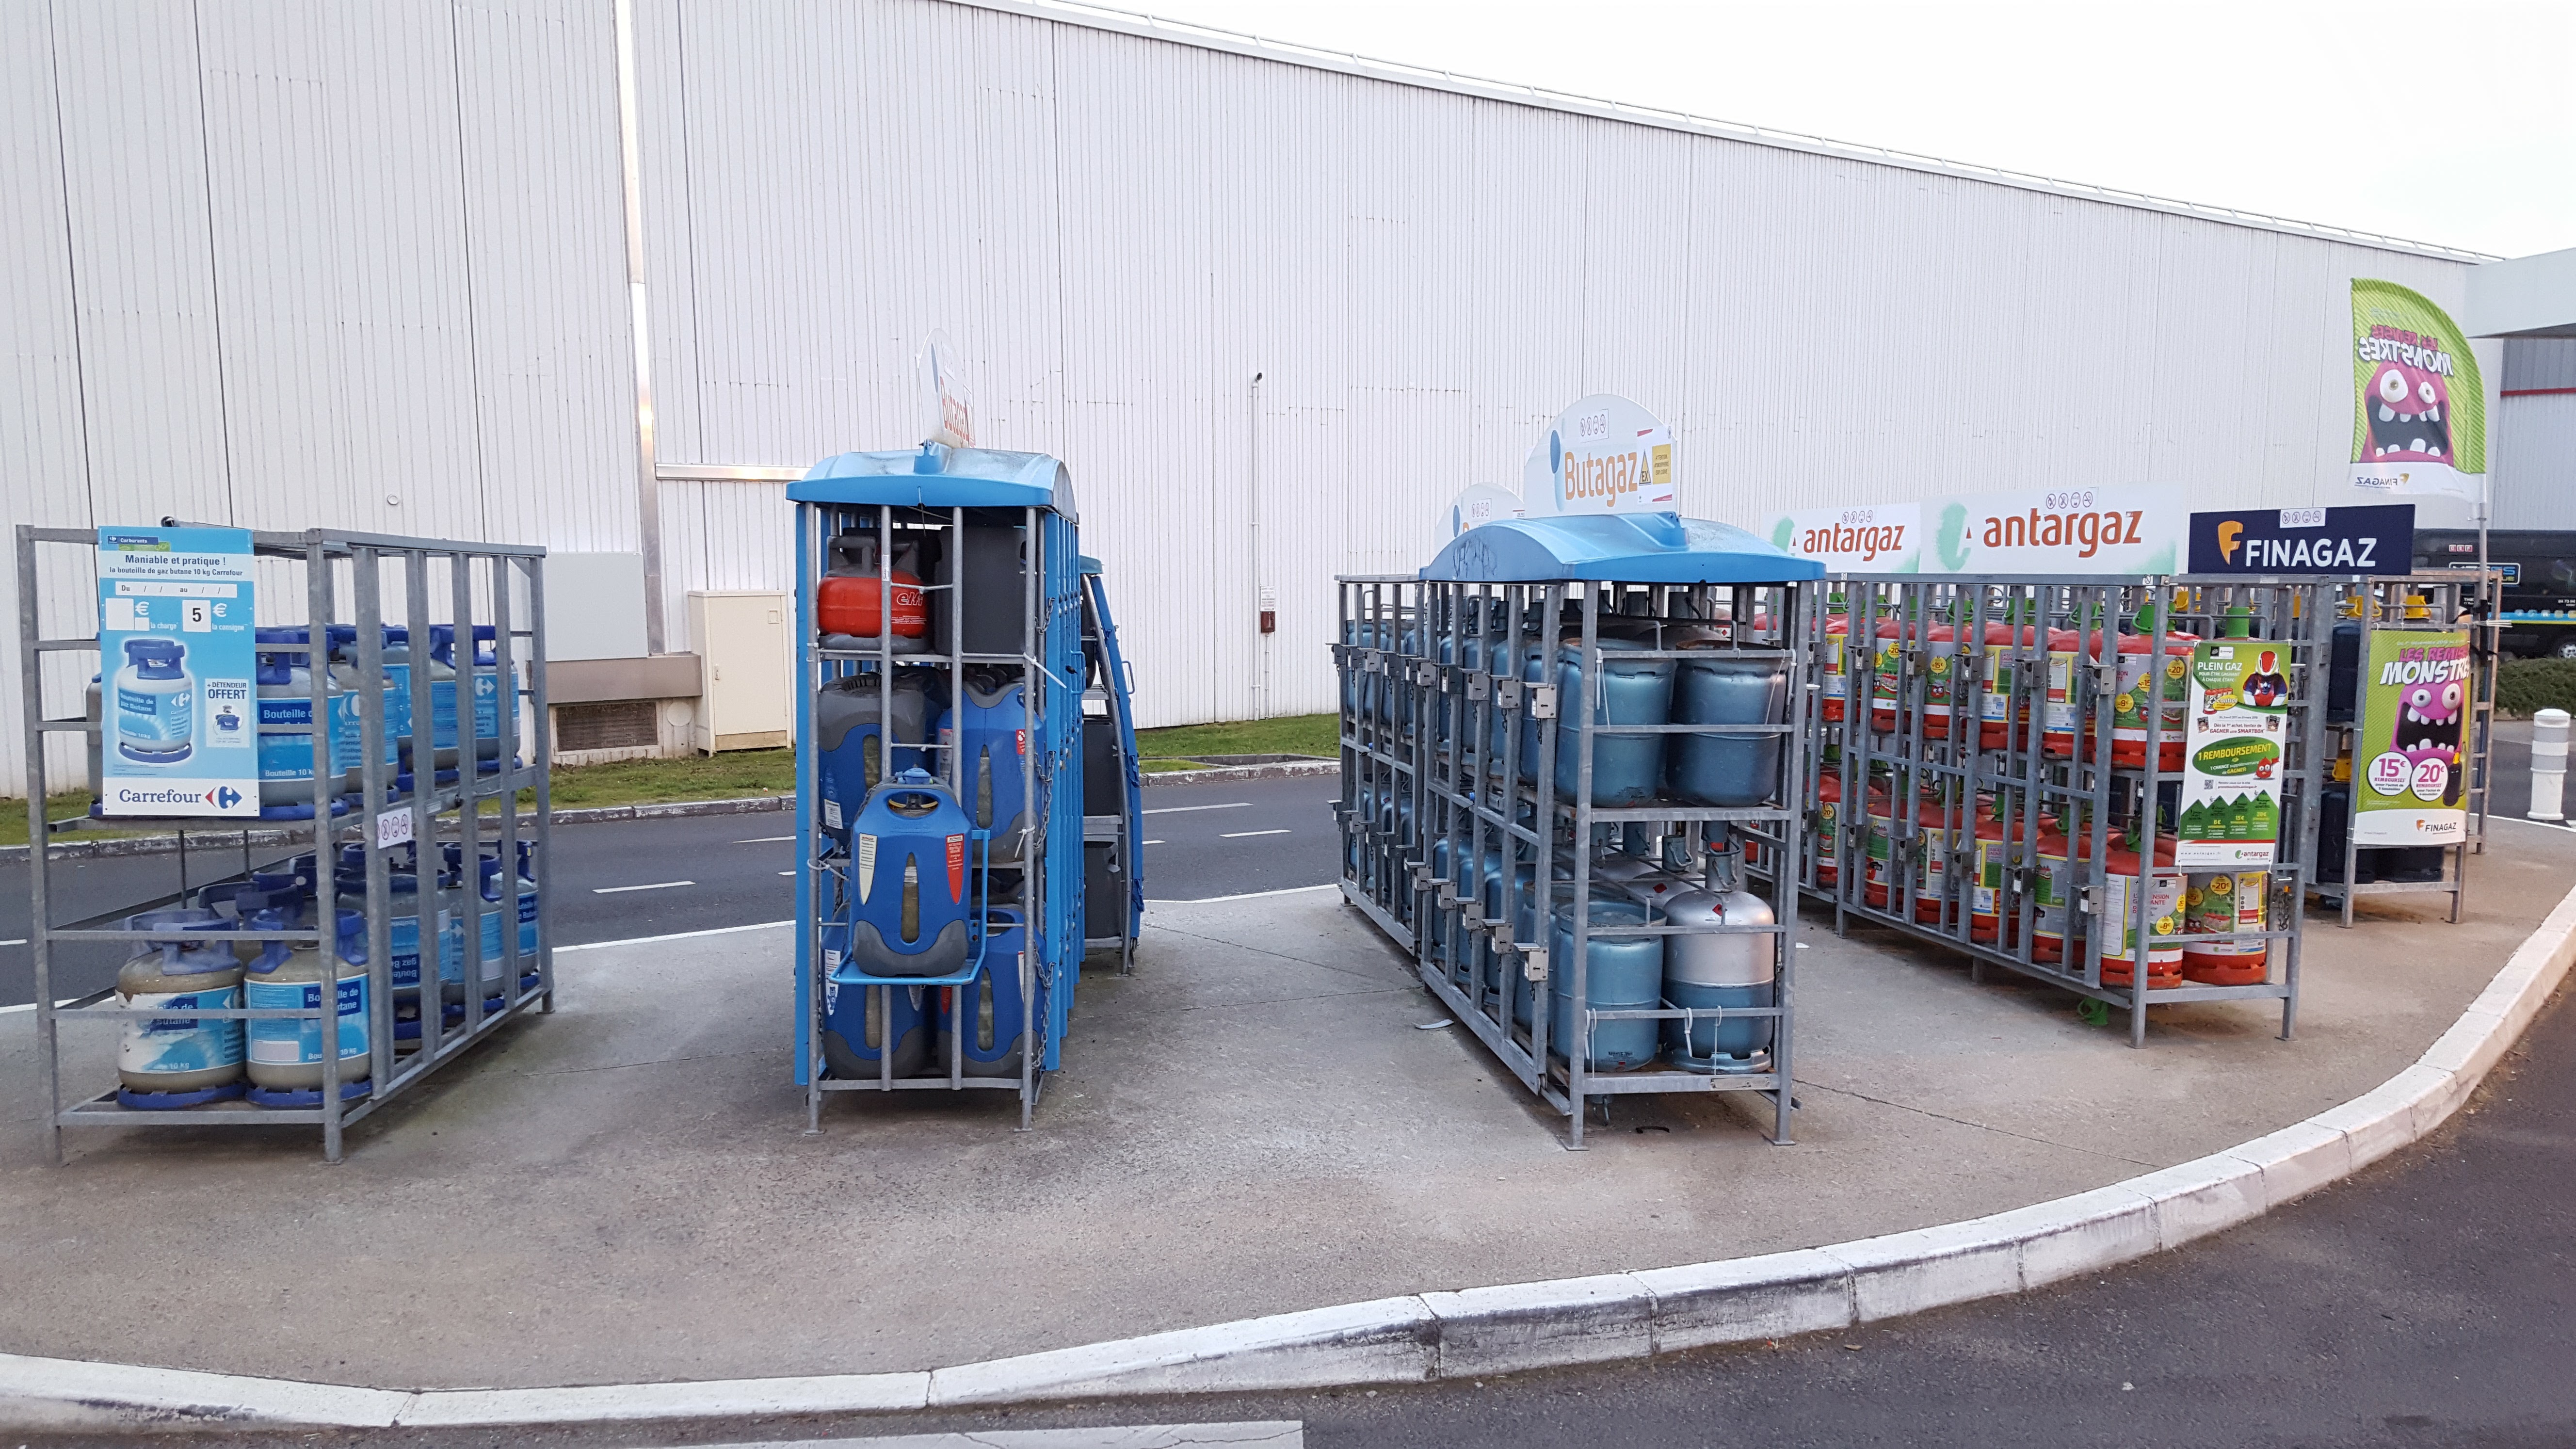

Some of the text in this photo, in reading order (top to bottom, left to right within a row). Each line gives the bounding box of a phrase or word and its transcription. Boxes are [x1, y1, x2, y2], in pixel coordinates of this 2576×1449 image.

[1565, 451, 1638, 507] Butagaz
[1642, 471, 1648, 482] EX
[1983, 508, 2143, 558] antargaz
[1803, 522, 1905, 562] antargaz
[2246, 538, 2377, 567] FINAGAZ
[125, 555, 168, 564] Maniable
[182, 557, 220, 566] pratique
[135, 601, 149, 615] €
[192, 603, 227, 622] 5 €
[2399, 647, 2424, 662] LES
[2198, 662, 2242, 671] PLEIN GAZ
[208, 689, 247, 699] OFFERT
[264, 709, 306, 718] Bouteille
[2198, 752, 2202, 760] 1
[2203, 743, 2272, 760] REMBOURSEMENT
[2379, 758, 2406, 777] 15€
[2418, 764, 2445, 783] 20€
[119, 789, 201, 803] Carrefour
[2425, 822, 2457, 832] FINAGAZ
[349, 988, 358, 997] de
